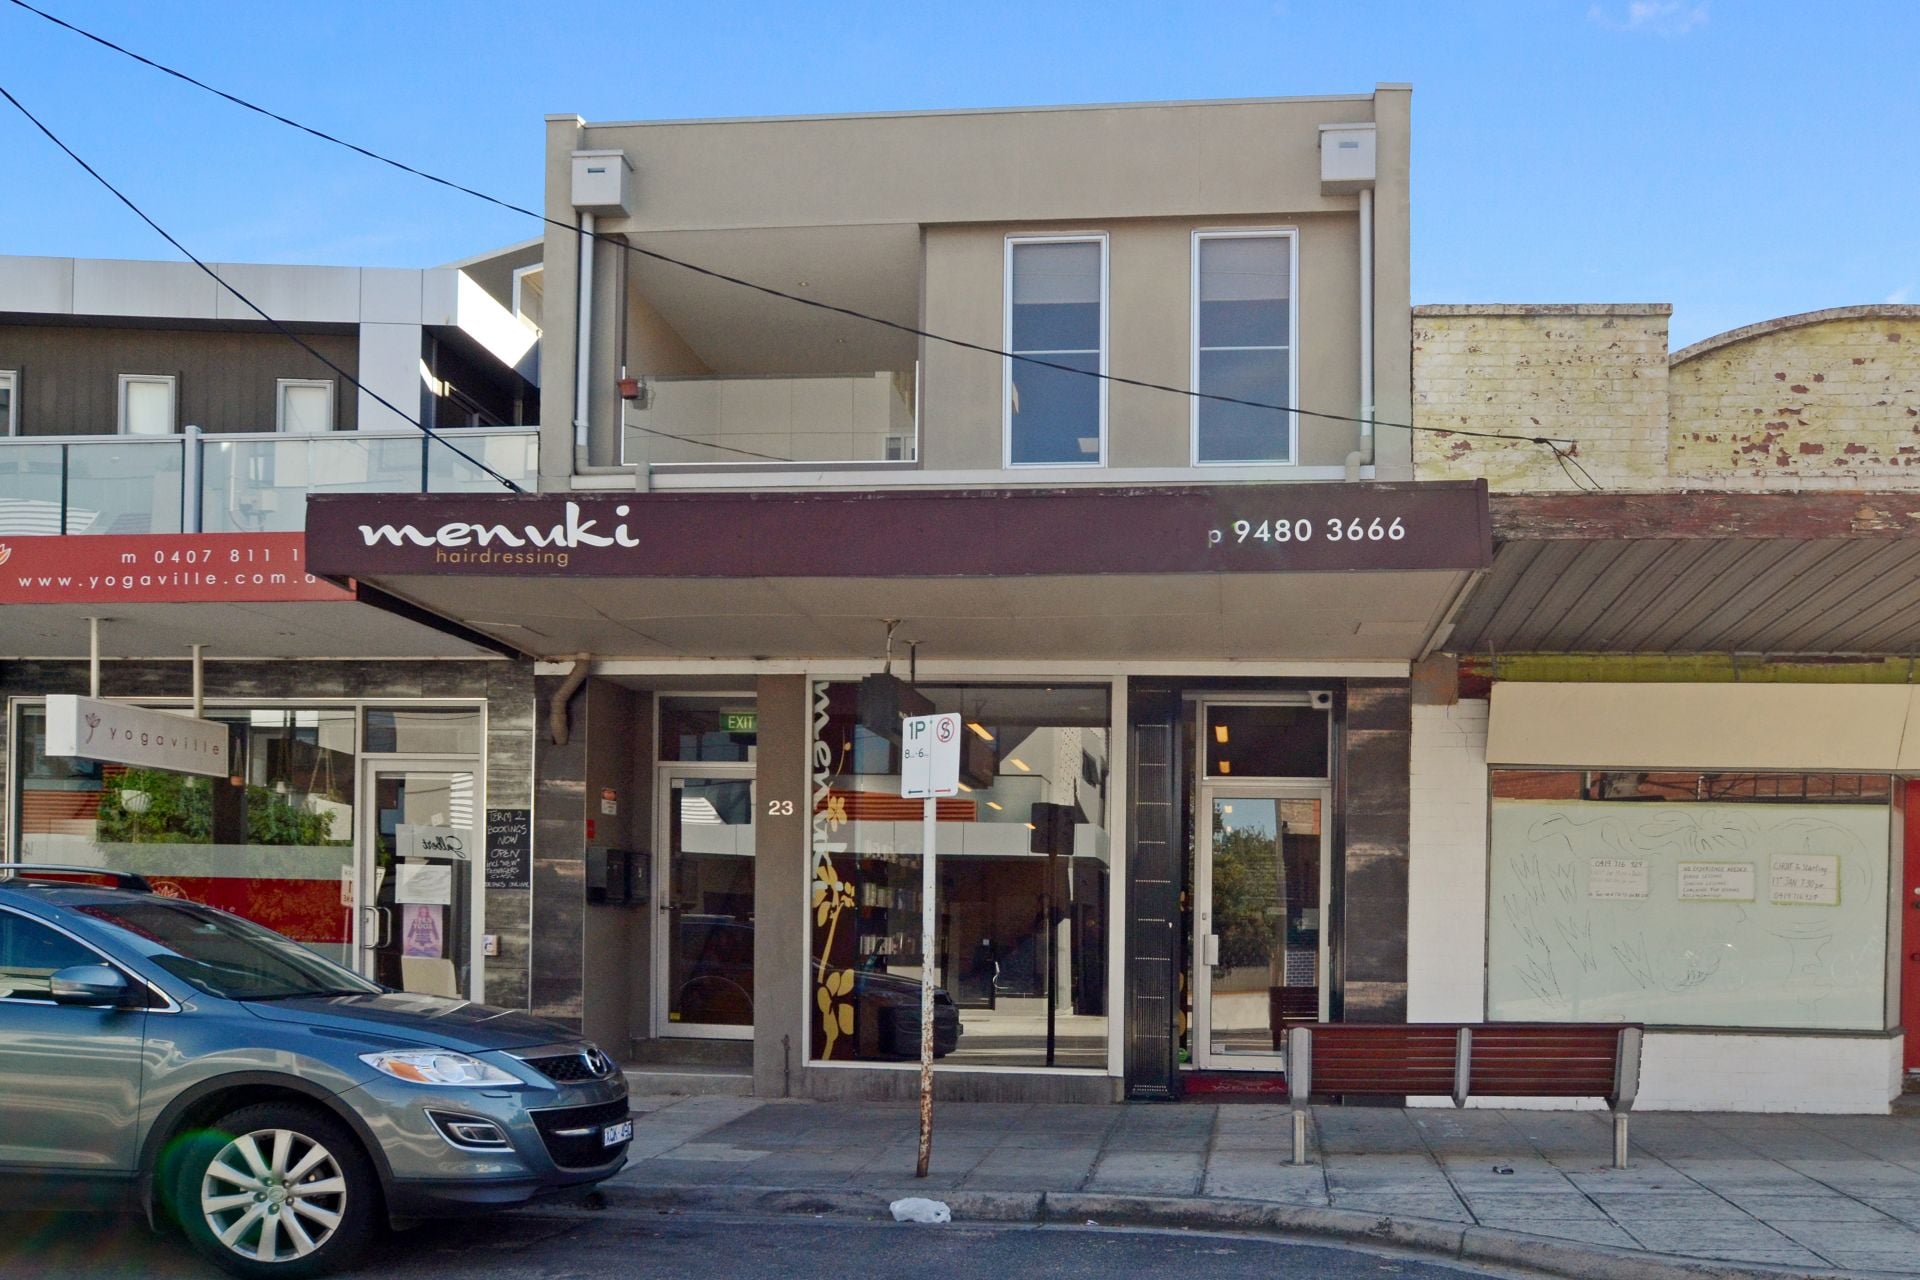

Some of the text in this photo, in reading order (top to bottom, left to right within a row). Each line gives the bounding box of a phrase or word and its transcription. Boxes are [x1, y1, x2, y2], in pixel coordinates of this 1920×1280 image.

[358, 501, 640, 548] menuki
[1208, 517, 1405, 548] p 9480 3666
[121, 552, 137, 564] m
[154, 549, 213, 564] 0407
[229, 548, 271, 562] 811
[436, 548, 569, 567] hairdressing
[18, 572, 316, 589] www.yogaville.com.a
[728, 715, 754, 729] EXIT
[909, 720, 926, 740] 1P
[109, 727, 220, 755] yogaville
[488, 810, 512, 822] TERM
[768, 800, 794, 816] 23
[497, 834, 518, 845] NOW
[490, 848, 520, 858] OPEN
